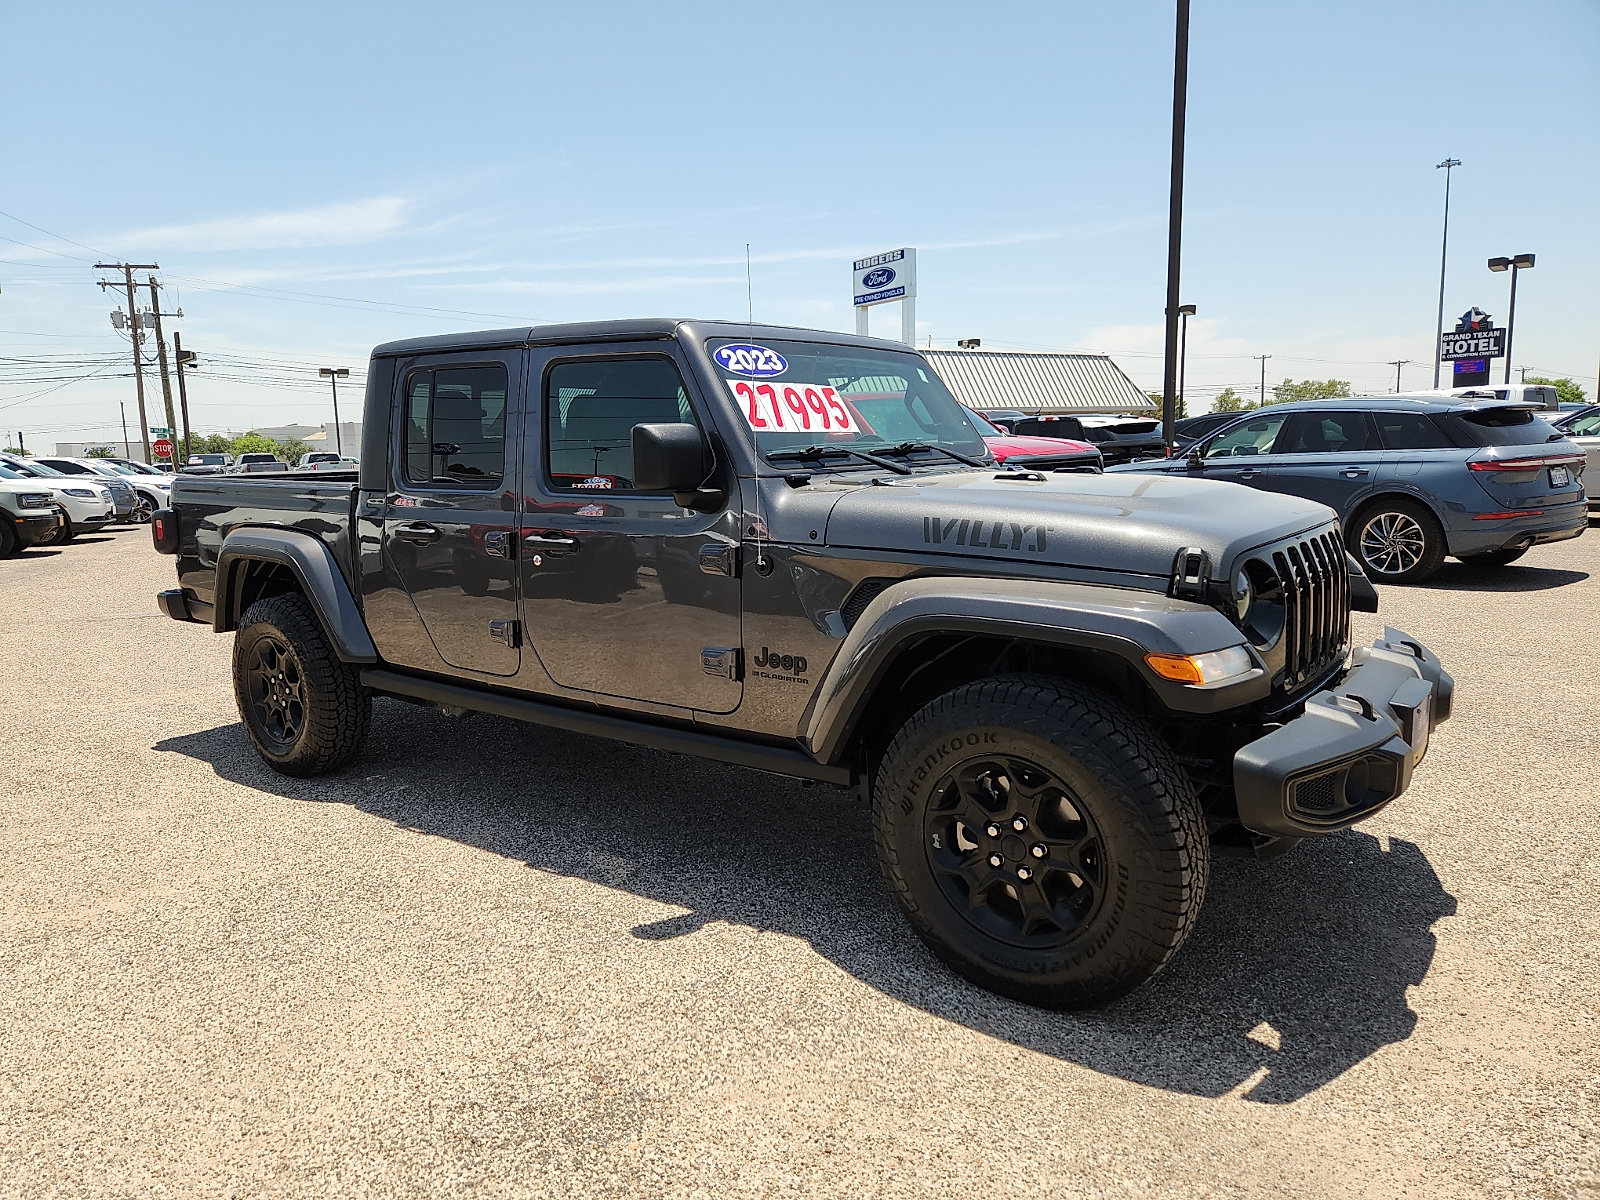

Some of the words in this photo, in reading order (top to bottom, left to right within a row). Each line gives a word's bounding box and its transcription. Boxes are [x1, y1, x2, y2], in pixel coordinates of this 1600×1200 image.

[855, 250, 902, 270] ROGERS
[868, 270, 889, 286] Ford
[855, 293, 882, 304] PRE-OWNED
[882, 287, 904, 298] VEHICLES
[1442, 333, 1471, 342] GRAND
[1473, 330, 1500, 339] TEXAN
[1442, 338, 1499, 355] HOTEL
[720, 348, 784, 371] 2023
[735, 382, 849, 430] 27995
[154, 444, 172, 453] STOP
[923, 516, 1054, 553] WILLYS
[754, 646, 808, 676] Jeep
[760, 671, 809, 685] GLADIATOR
